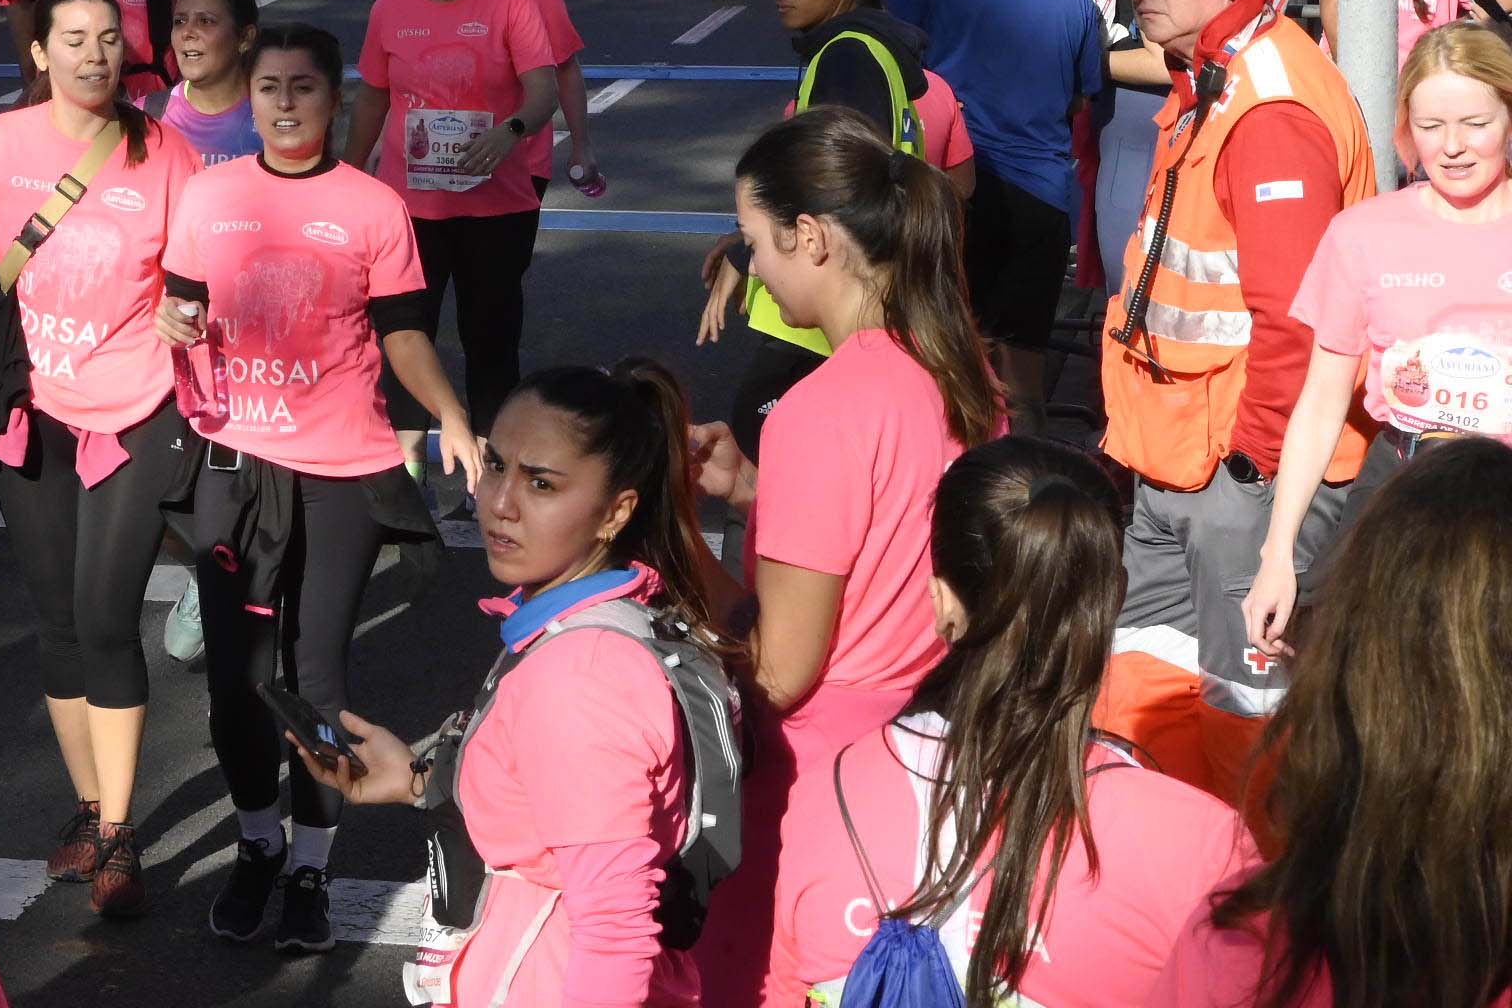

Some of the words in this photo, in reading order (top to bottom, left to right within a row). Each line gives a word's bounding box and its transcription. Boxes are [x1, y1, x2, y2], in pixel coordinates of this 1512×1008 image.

[432, 142, 461, 154] 016
[212, 220, 262, 233] OYSHO
[1381, 272, 1446, 288] OYSHO
[1435, 389, 1489, 411] 016
[1396, 413, 1438, 432] CARRERA
[1438, 410, 1481, 429] 29102
